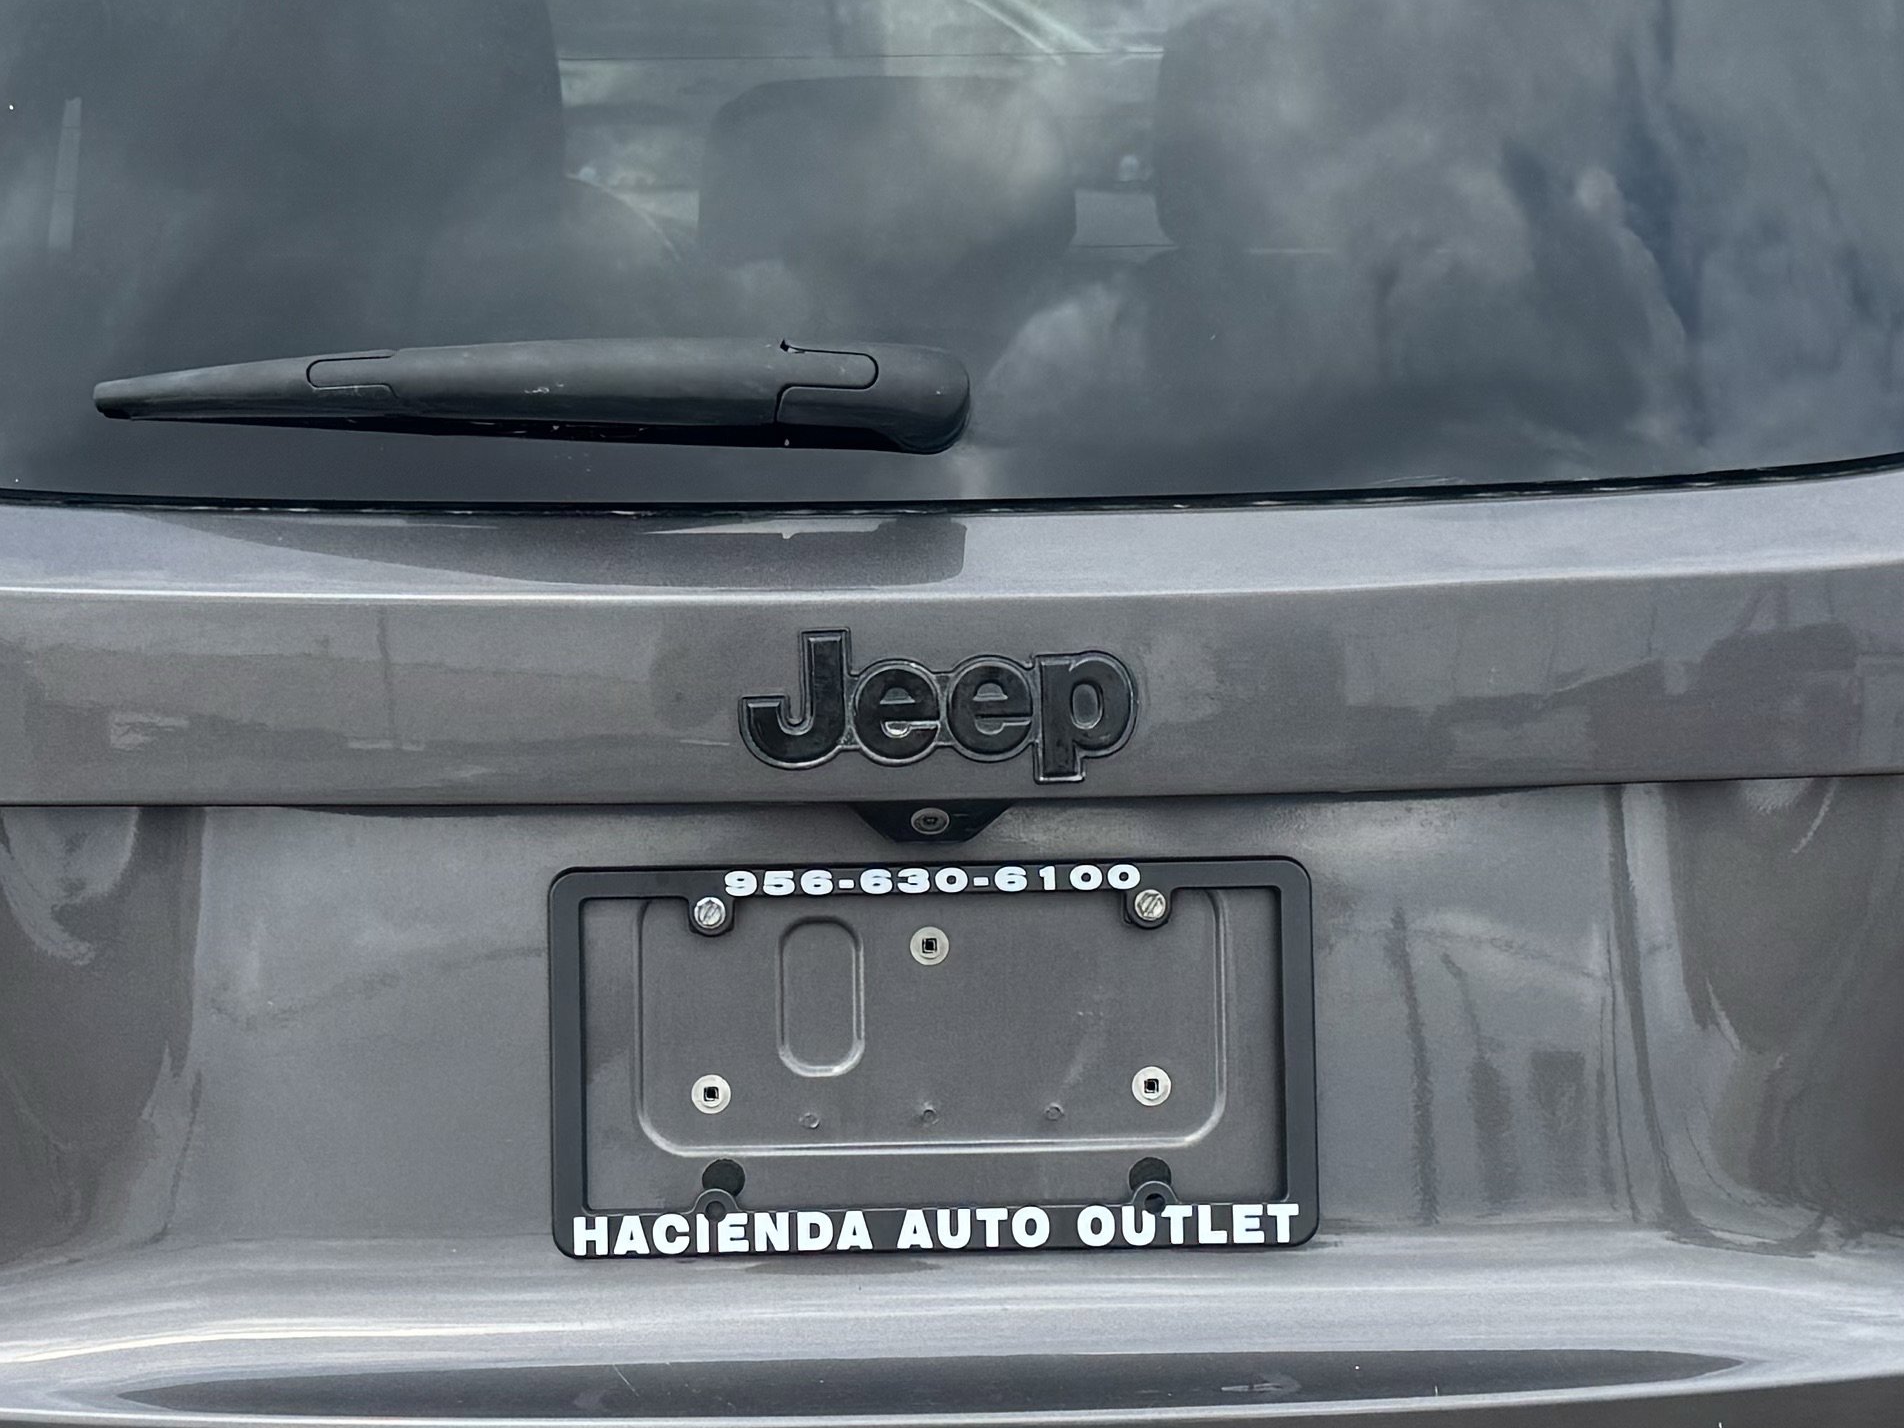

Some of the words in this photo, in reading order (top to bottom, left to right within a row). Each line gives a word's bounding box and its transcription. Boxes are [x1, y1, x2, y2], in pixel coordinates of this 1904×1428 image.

[739, 627, 1138, 784] Jeep
[725, 864, 1140, 896] 956-630-6100
[573, 1210, 873, 1256] HACIENDA
[897, 1205, 1050, 1249] AUTO
[1077, 1203, 1299, 1247] OUTLET
